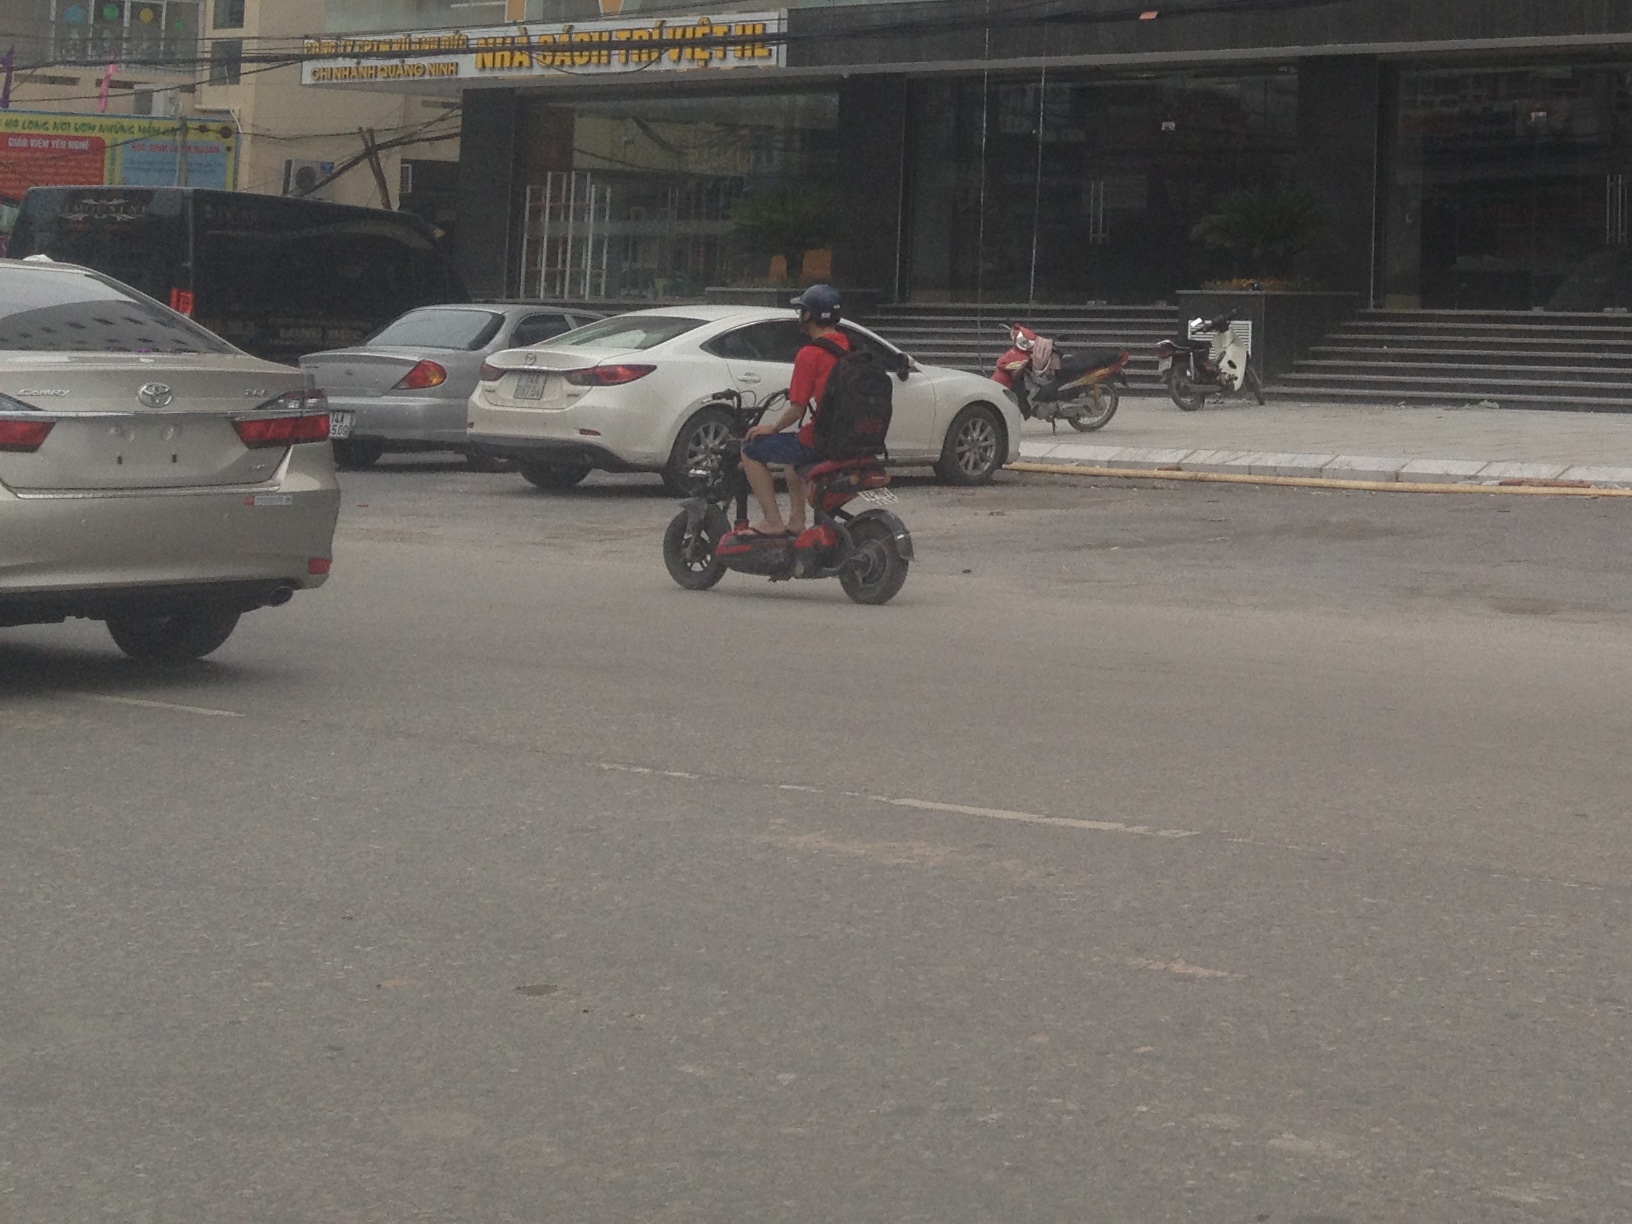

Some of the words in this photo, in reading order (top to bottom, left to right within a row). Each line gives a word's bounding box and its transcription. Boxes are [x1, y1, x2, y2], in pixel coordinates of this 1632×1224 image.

[475, 25, 533, 69] NHÀ
[310, 66, 333, 81] CHI
[334, 59, 375, 80] NHÁNH
[427, 61, 459, 76] NINH
[16, 387, 72, 398] CAMRY
